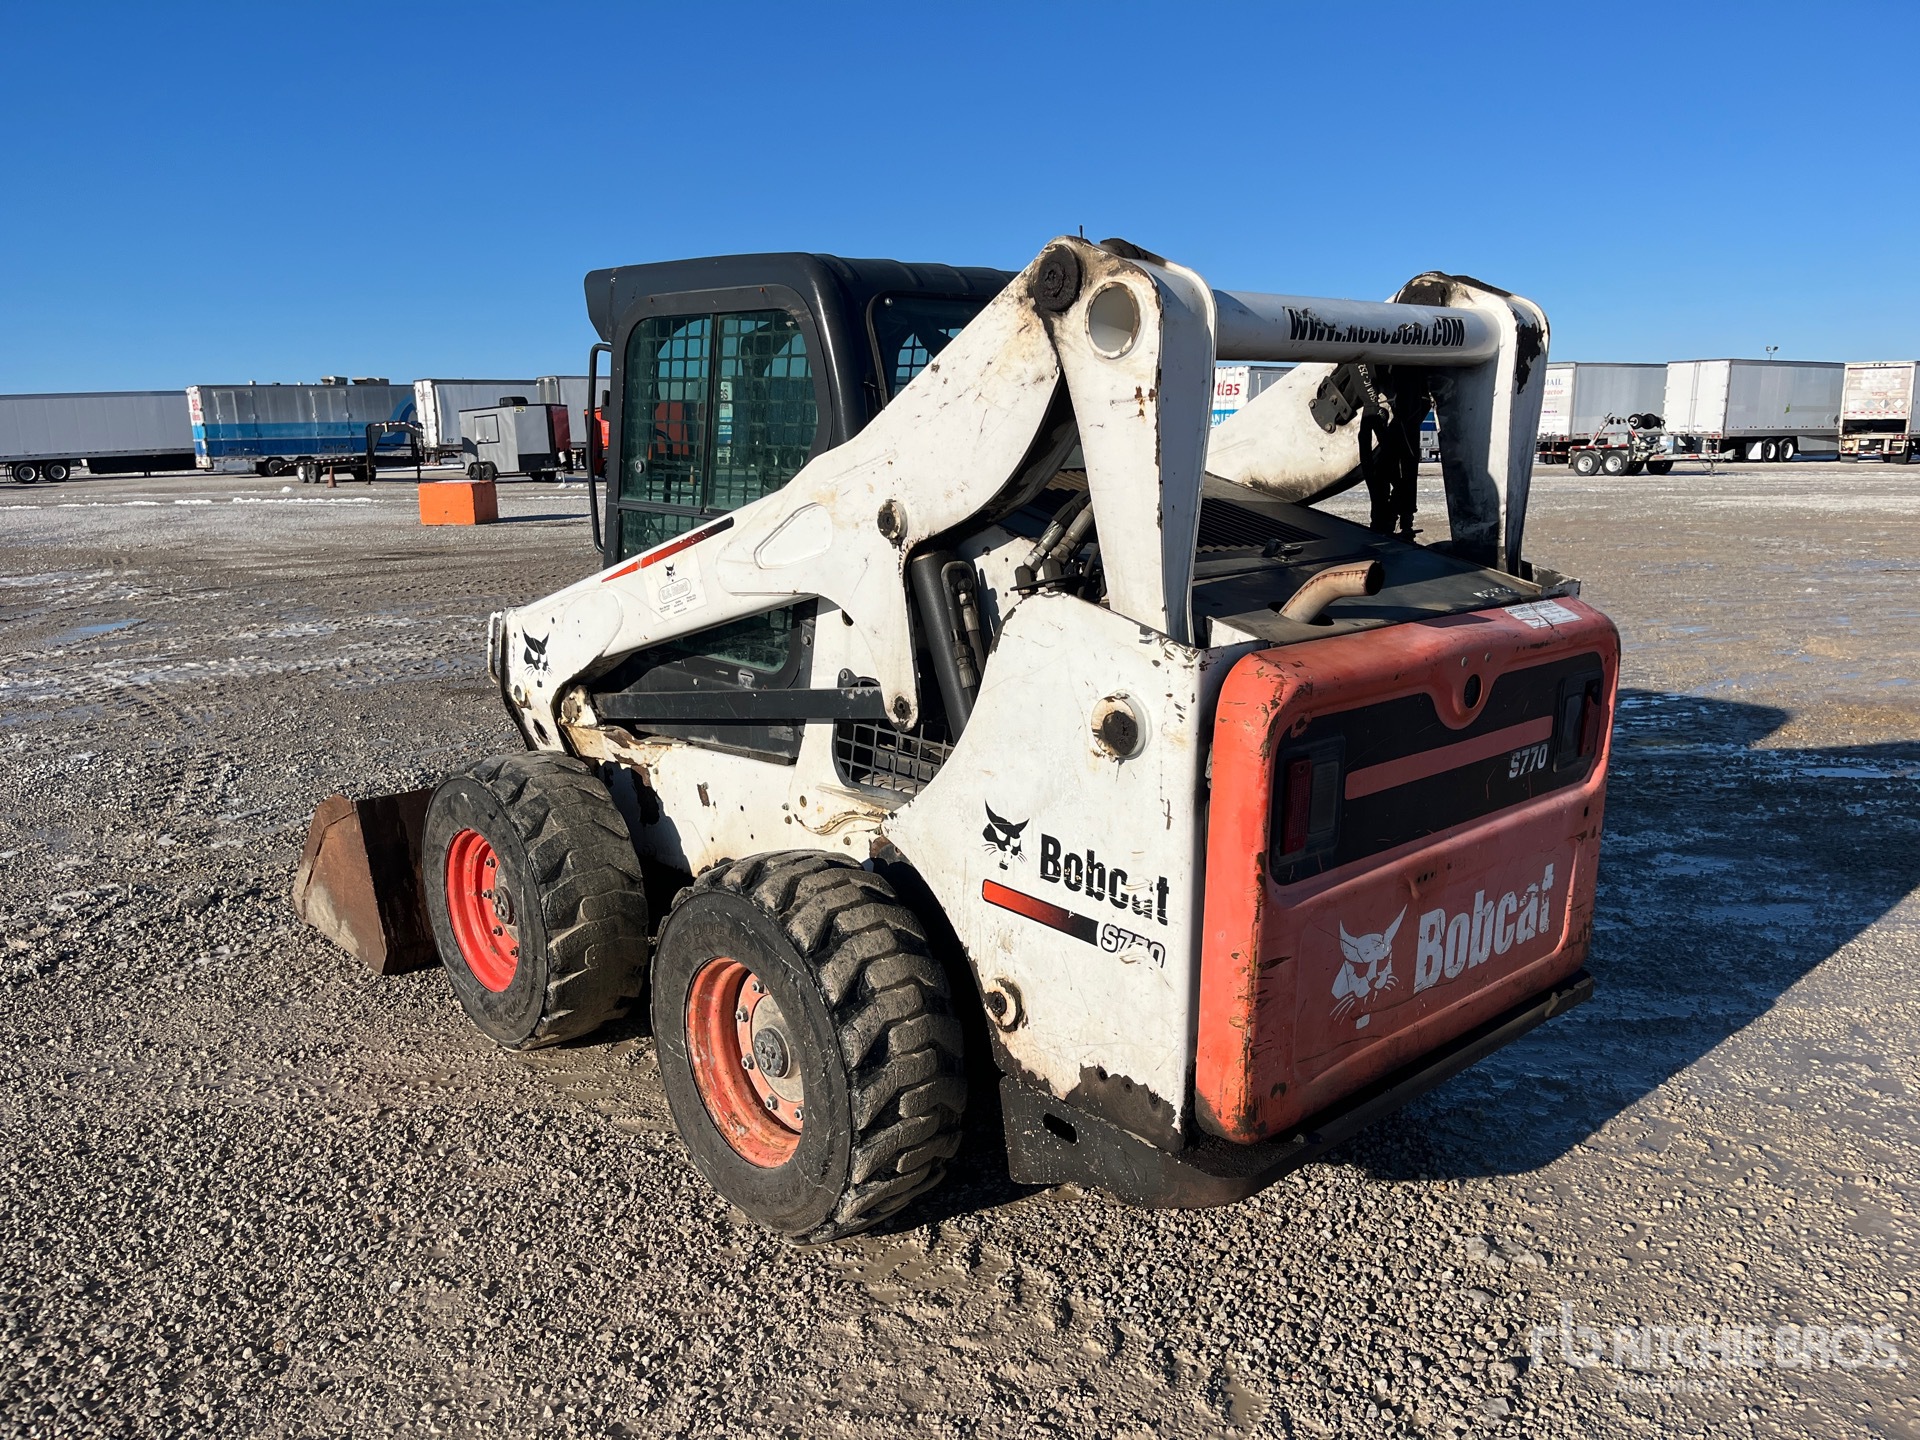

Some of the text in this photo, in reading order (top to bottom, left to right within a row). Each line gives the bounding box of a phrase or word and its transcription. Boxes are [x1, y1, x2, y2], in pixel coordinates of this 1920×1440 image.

[1216, 380, 1241, 396] tlas
[1509, 743, 1548, 779] S770
[1040, 833, 1169, 926] Bobcat
[1413, 863, 1554, 995] Bobcat
